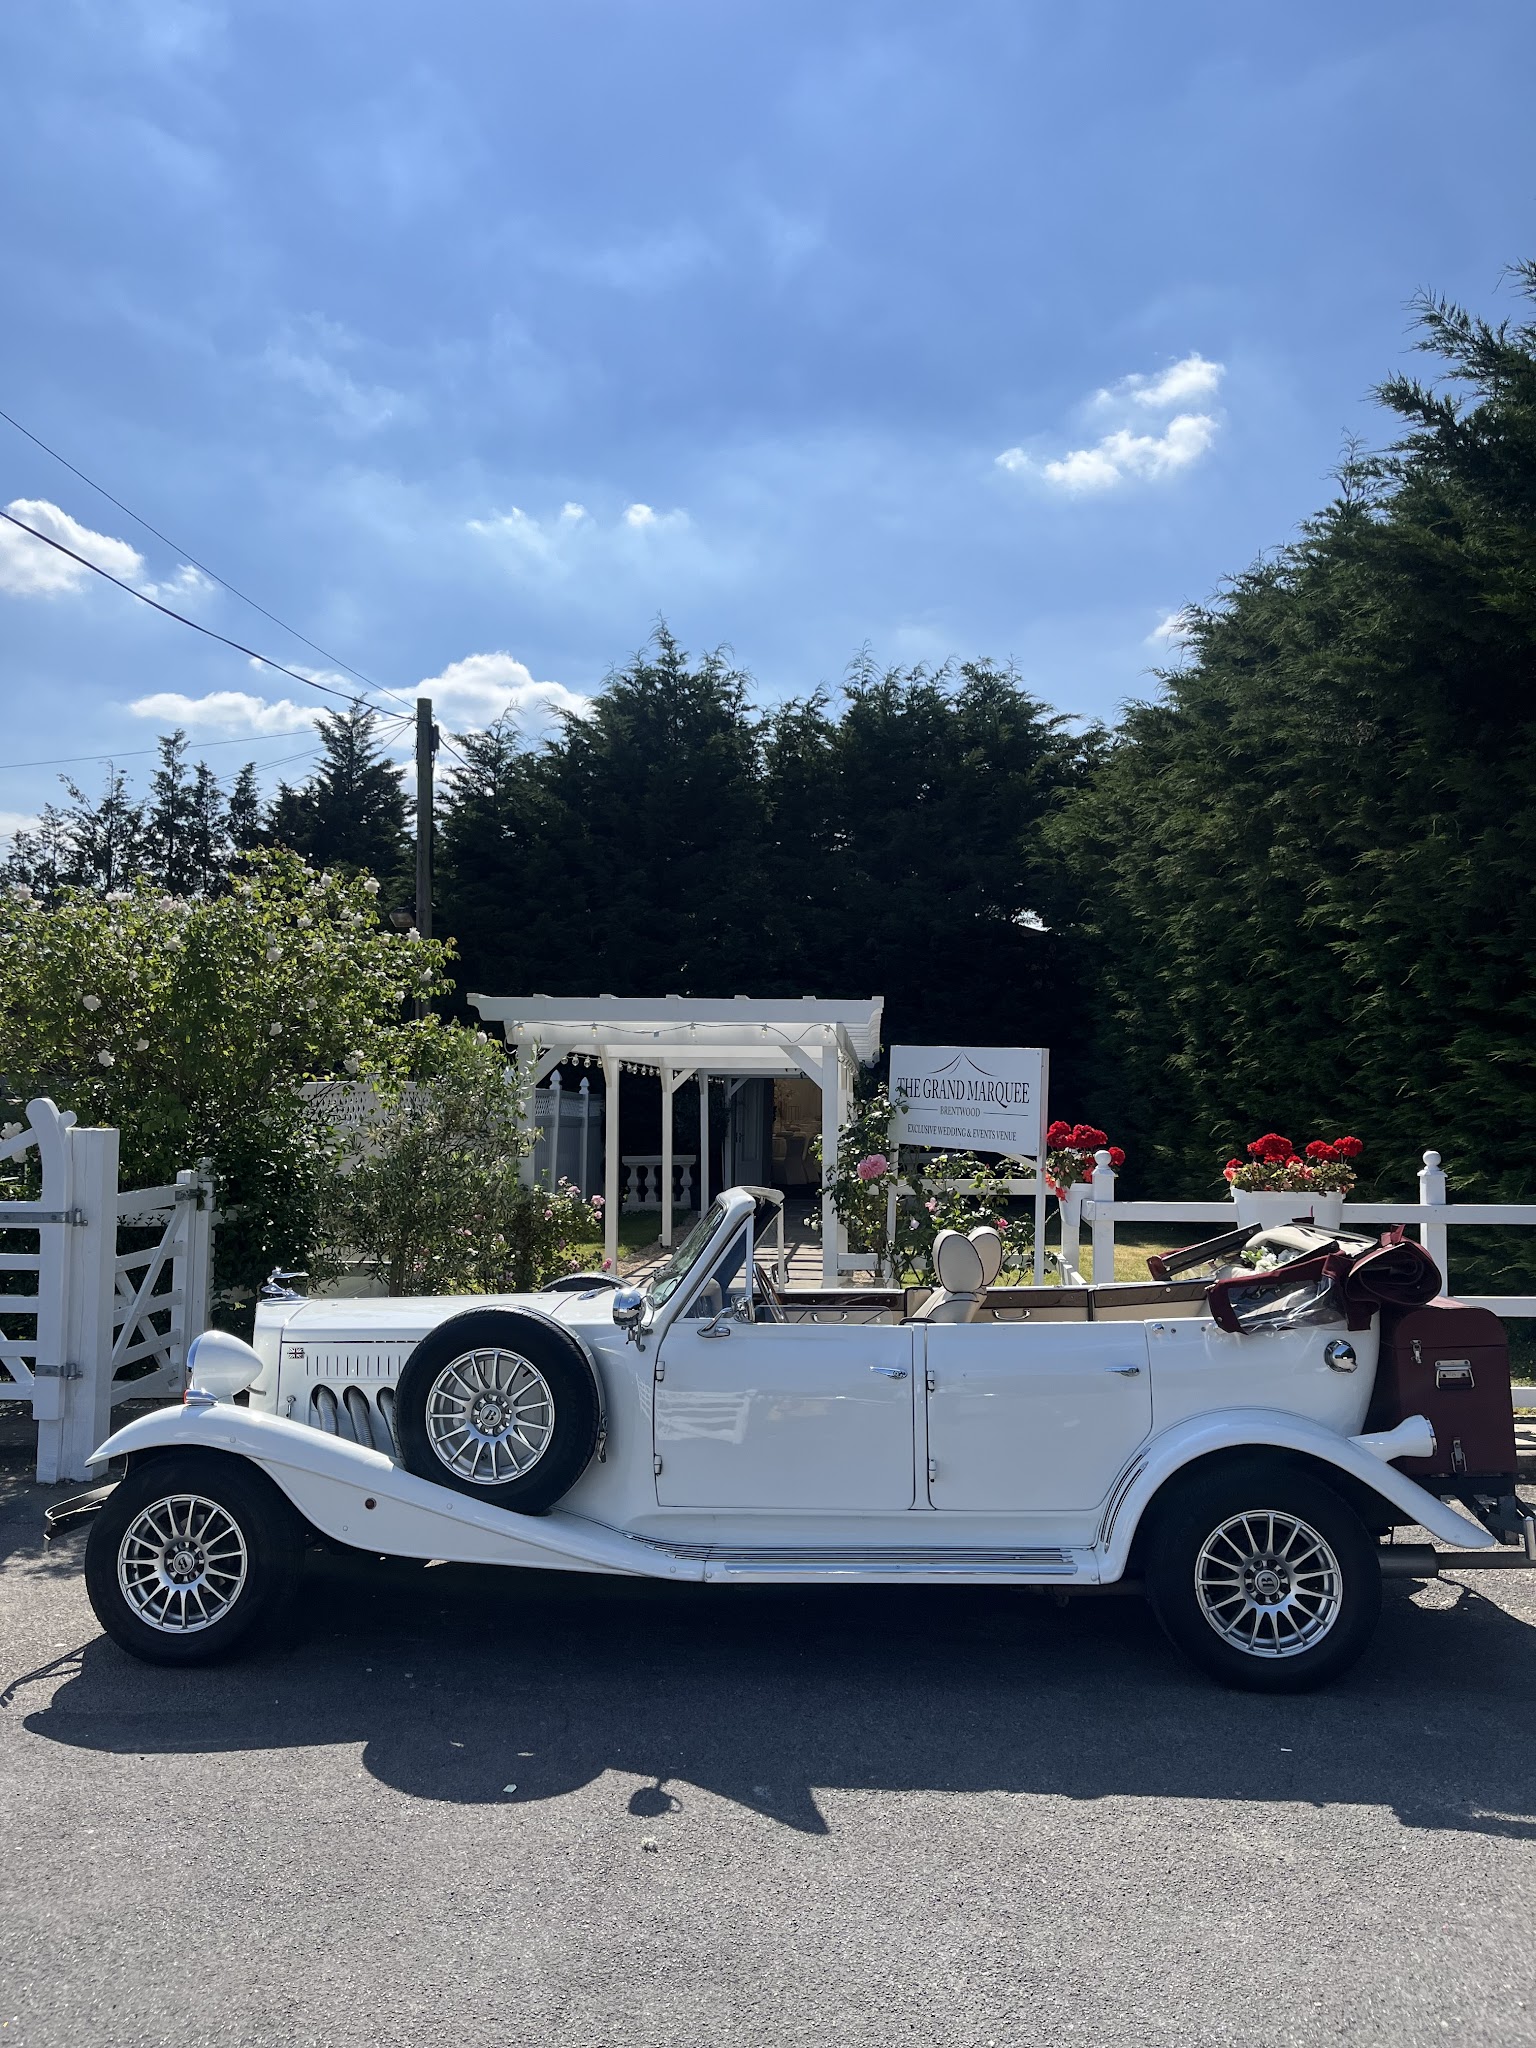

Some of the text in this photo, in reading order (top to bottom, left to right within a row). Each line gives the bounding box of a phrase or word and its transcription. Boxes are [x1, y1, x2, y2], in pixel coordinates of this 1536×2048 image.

[897, 1077, 1030, 1108] THE GRAND MARQUEE
[940, 1106, 981, 1117] BRENTWOOD
[907, 1123, 1017, 1141] EXCLUSIVE WEDDING & EVENTS VENUE
